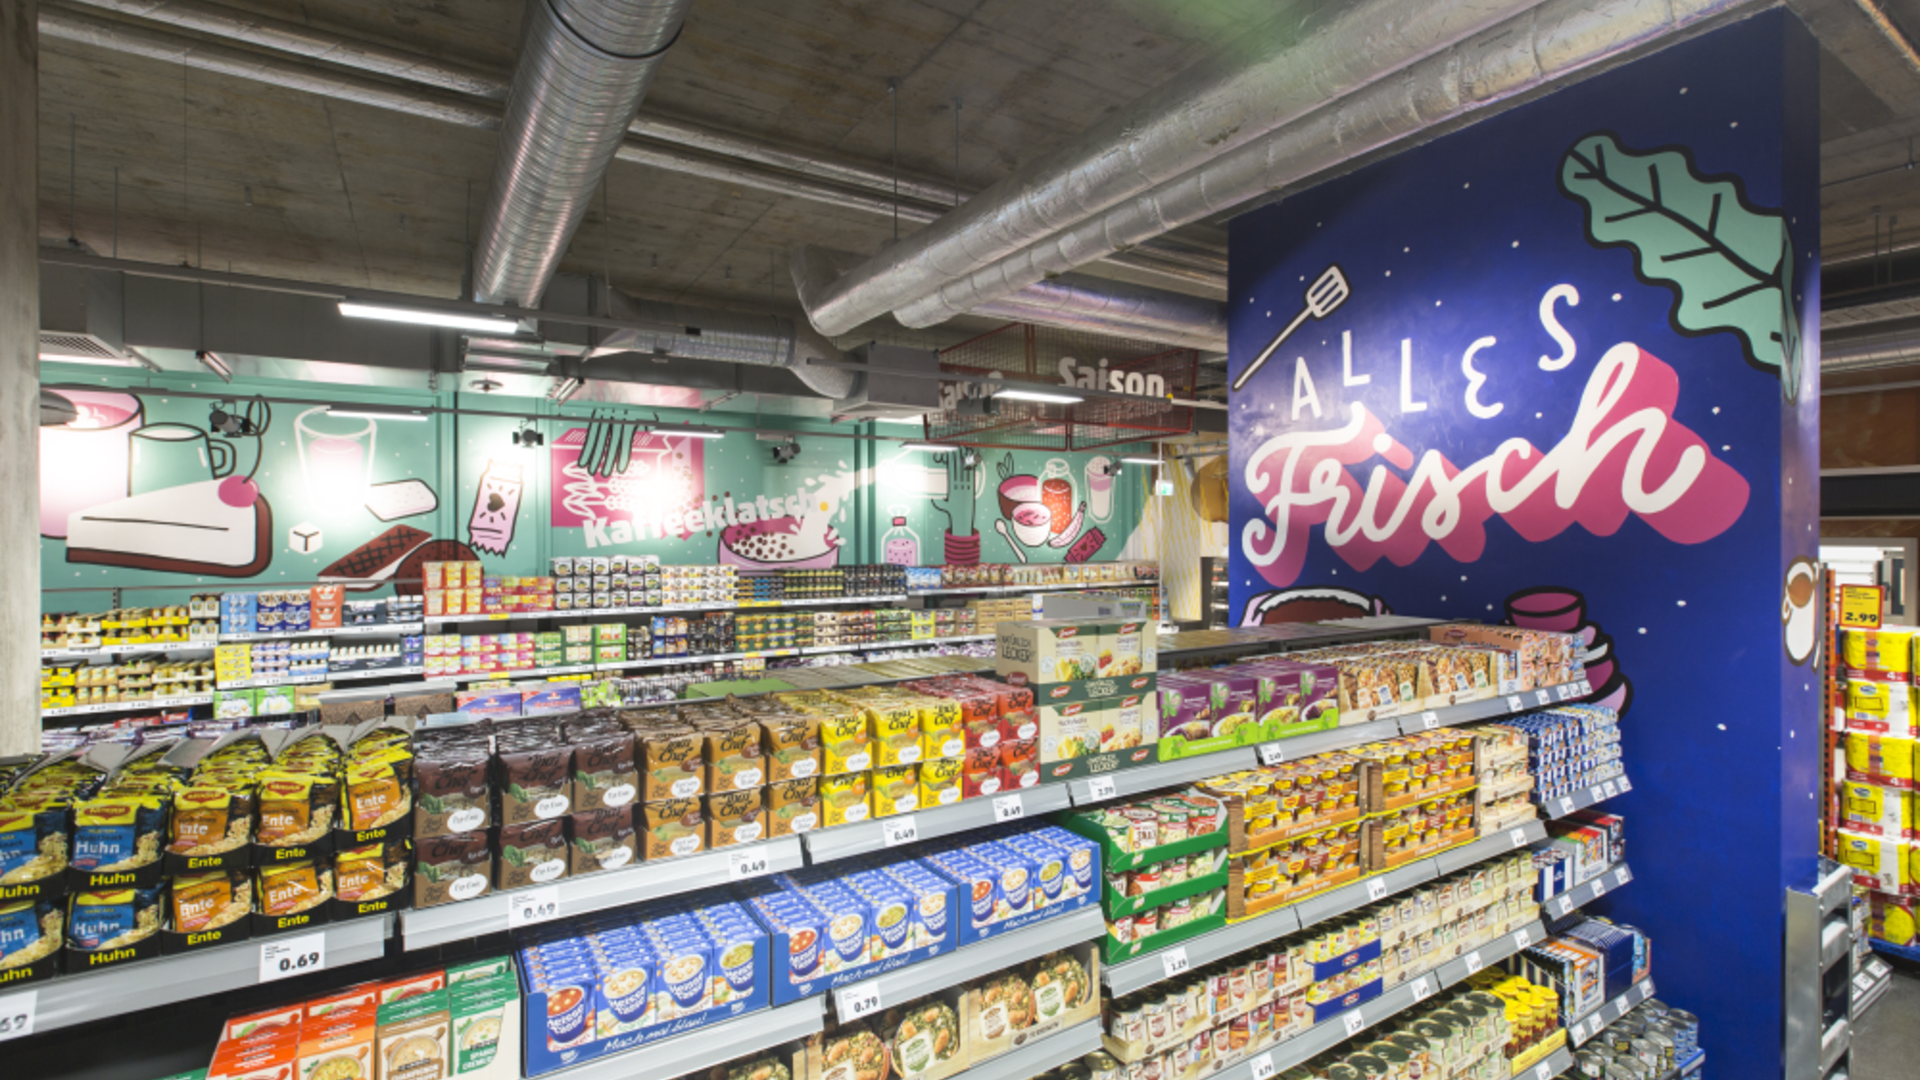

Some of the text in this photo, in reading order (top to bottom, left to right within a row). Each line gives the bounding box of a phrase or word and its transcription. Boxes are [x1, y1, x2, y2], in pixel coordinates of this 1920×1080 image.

[1291, 283, 1579, 420] ALLES
[1242, 341, 1706, 567] Frisch
[1844, 611, 1878, 623] 2.99
[356, 794, 387, 810] Ente
[262, 814, 294, 826] Ente
[356, 829, 387, 842] Ente
[75, 841, 120, 854] Huhn
[275, 848, 307, 860] Ente
[187, 856, 223, 869] Ente
[741, 860, 766, 874] 0.49
[89, 873, 136, 886] Huhn
[339, 874, 370, 888] Ente
[0, 884, 40, 898] uhn
[269, 886, 302, 902] Ente
[179, 897, 215, 916] Ente
[358, 900, 388, 914] Ente
[278, 914, 310, 928] Ente
[74, 921, 120, 936] Huhn
[187, 930, 222, 945] Ente
[89, 948, 136, 965] Huhn
[279, 952, 320, 972] 0.69
